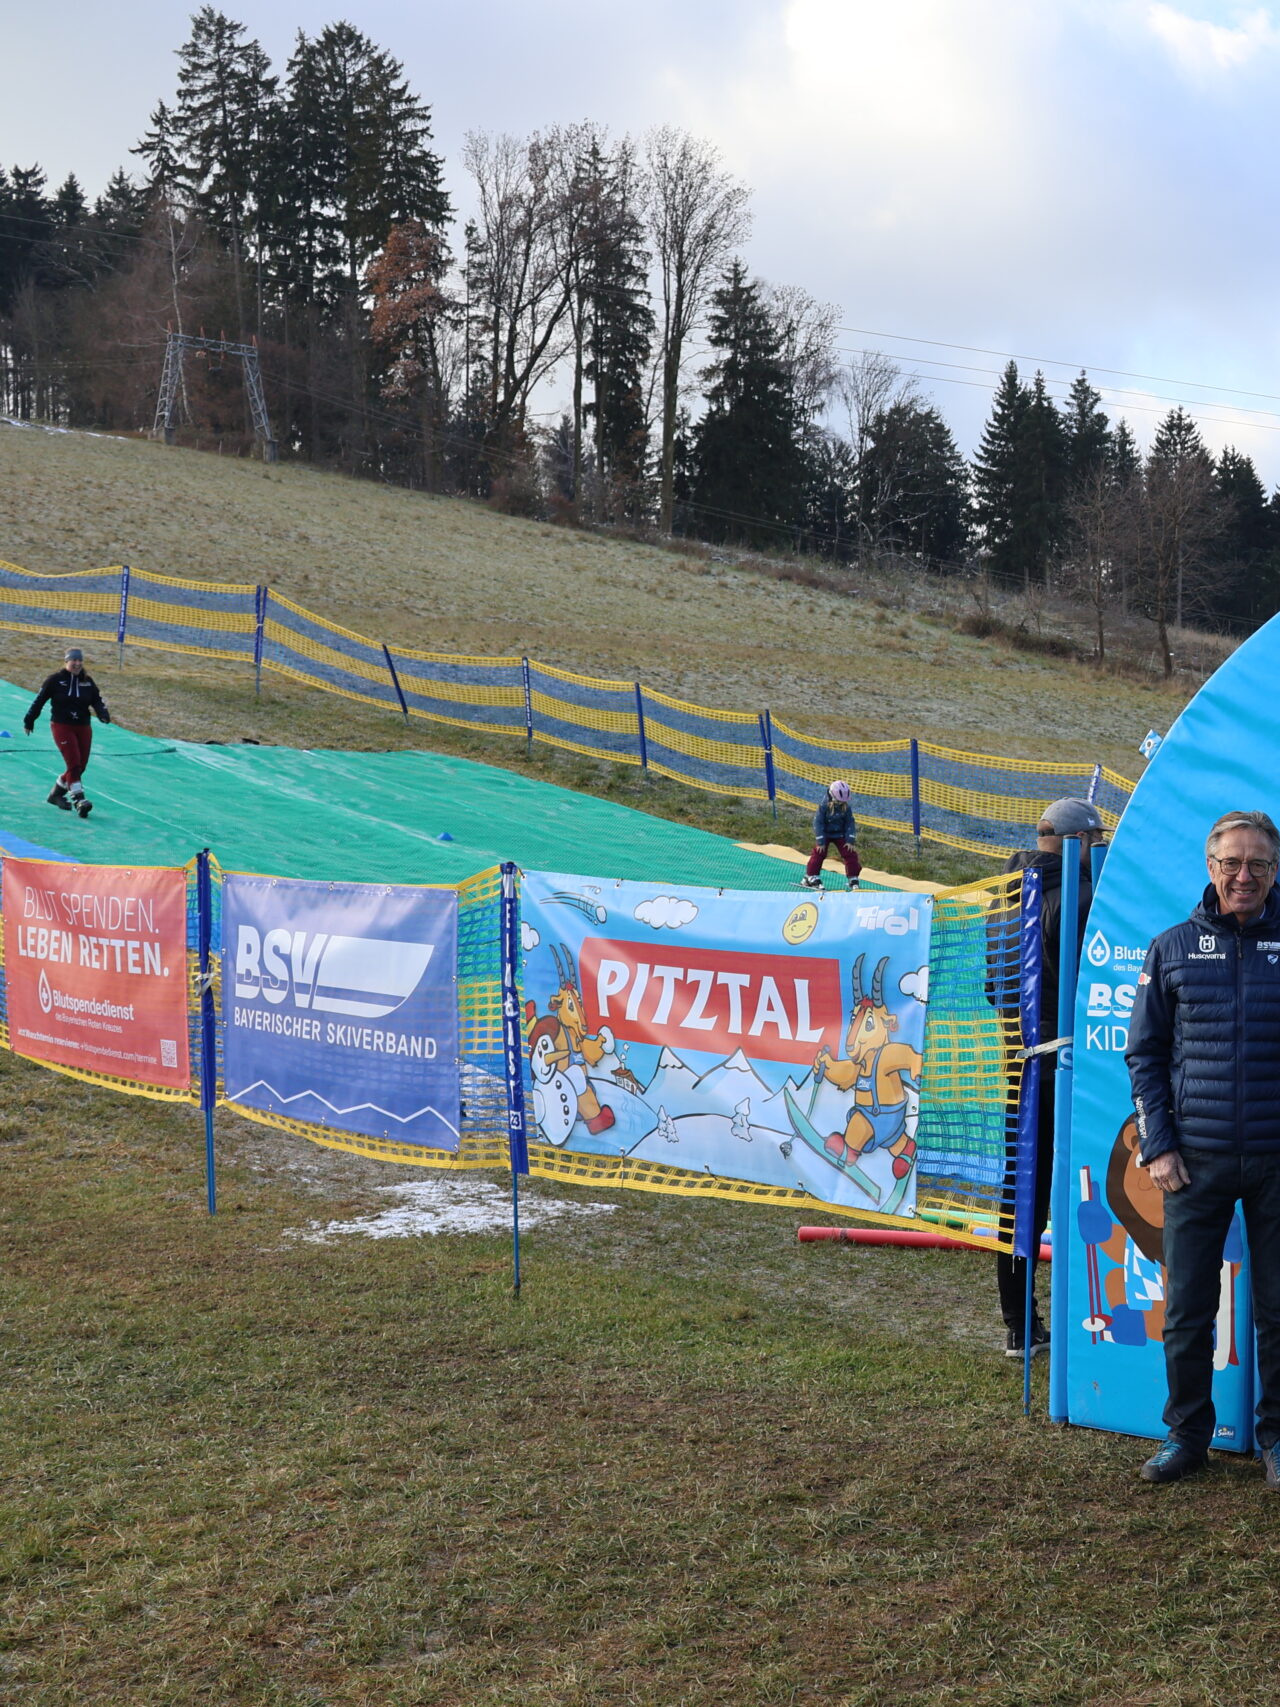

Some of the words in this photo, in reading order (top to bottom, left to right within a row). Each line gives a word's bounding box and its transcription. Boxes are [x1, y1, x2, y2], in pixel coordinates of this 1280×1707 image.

[23, 886, 60, 922] BLUT
[60, 891, 160, 934] SPENDEN.
[856, 905, 919, 936] Tirol
[17, 924, 73, 965] LEBEN
[78, 933, 170, 978] RETTEN.
[235, 924, 329, 1009] BSV
[1187, 951, 1226, 960] Husqvarna
[52, 989, 135, 1021] Blutspendedienst
[597, 958, 825, 1044] PITZTAL
[1086, 982, 1138, 1019] BS
[234, 1006, 321, 1042] BAYERISCHER
[326, 1022, 438, 1060] SKIVERBAND
